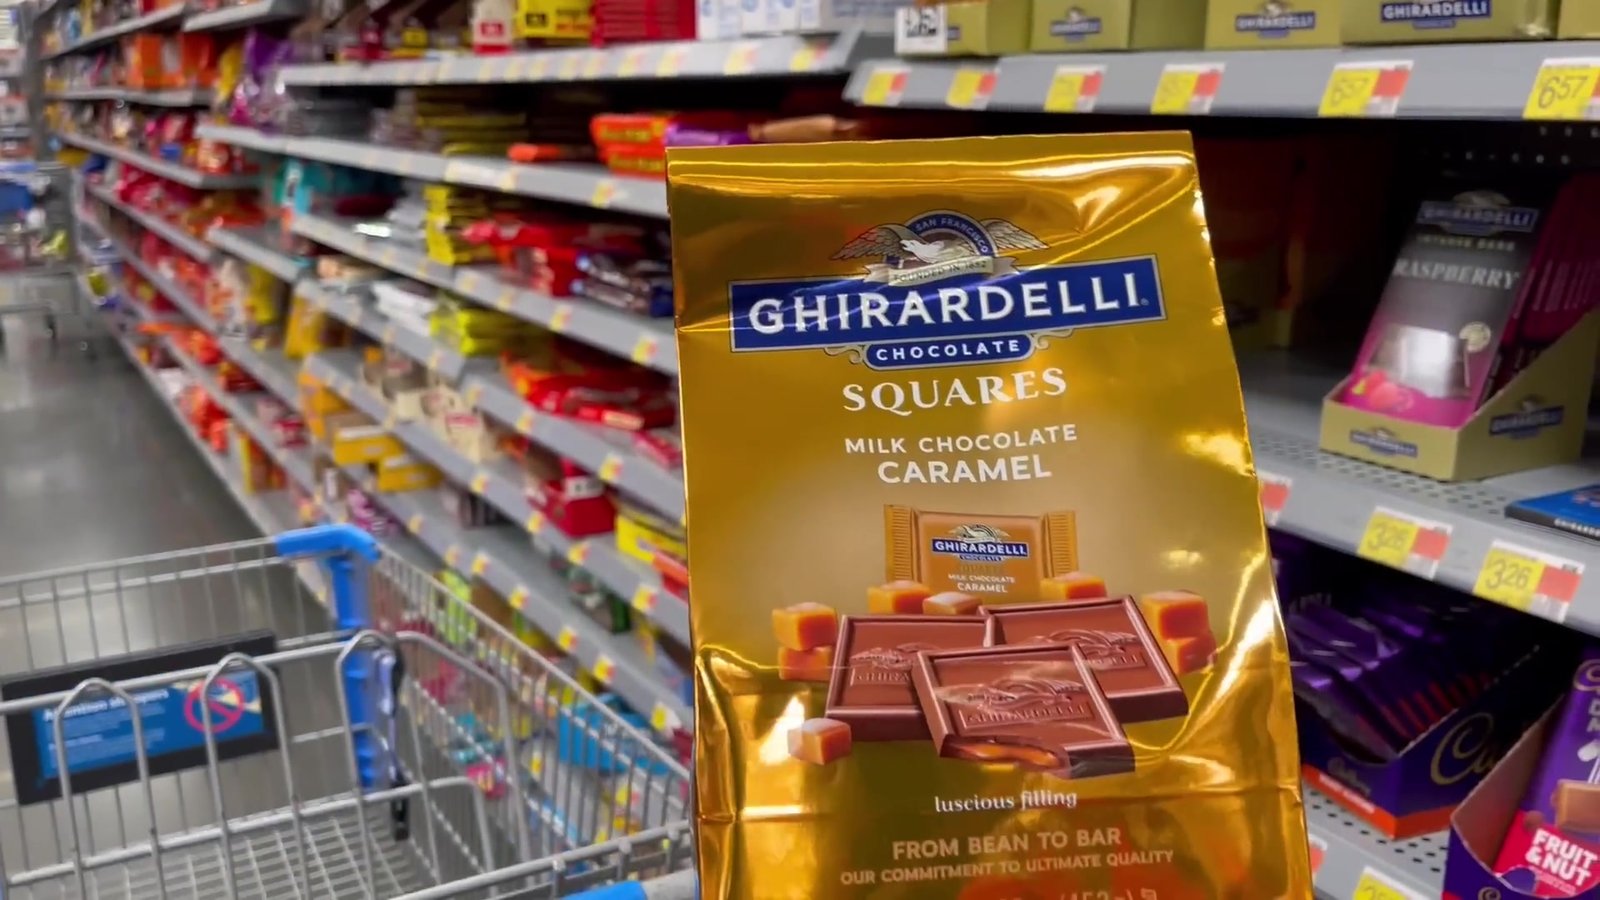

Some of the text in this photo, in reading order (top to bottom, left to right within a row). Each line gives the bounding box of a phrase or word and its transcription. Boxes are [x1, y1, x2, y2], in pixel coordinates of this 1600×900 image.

[1383, 1, 1489, 20] GHIRARDELLI
[1537, 75, 1589, 109] 657
[915, 216, 989, 253] SAN FRANCISCO
[1392, 257, 1520, 290] RASPBERRY
[749, 272, 1140, 334] GHIRARDELLI
[875, 339, 1020, 361] CHOCOLATE
[842, 367, 1067, 416] SQUARES
[845, 424, 1077, 454] MILK CHOCOLATE
[877, 454, 1052, 484] CARAMEL
[934, 541, 1027, 555] GHIRARDELLI
[957, 582, 1008, 593] CARAMEL
[1486, 558, 1532, 590] 326
[934, 789, 1078, 813] luscious filling
[892, 827, 1121, 860] FROM BEAN TO BAR
[1532, 827, 1598, 869] FRUIT
[840, 849, 1175, 885] OUR COMMITMENT TO ULTIMATE QUALITY
